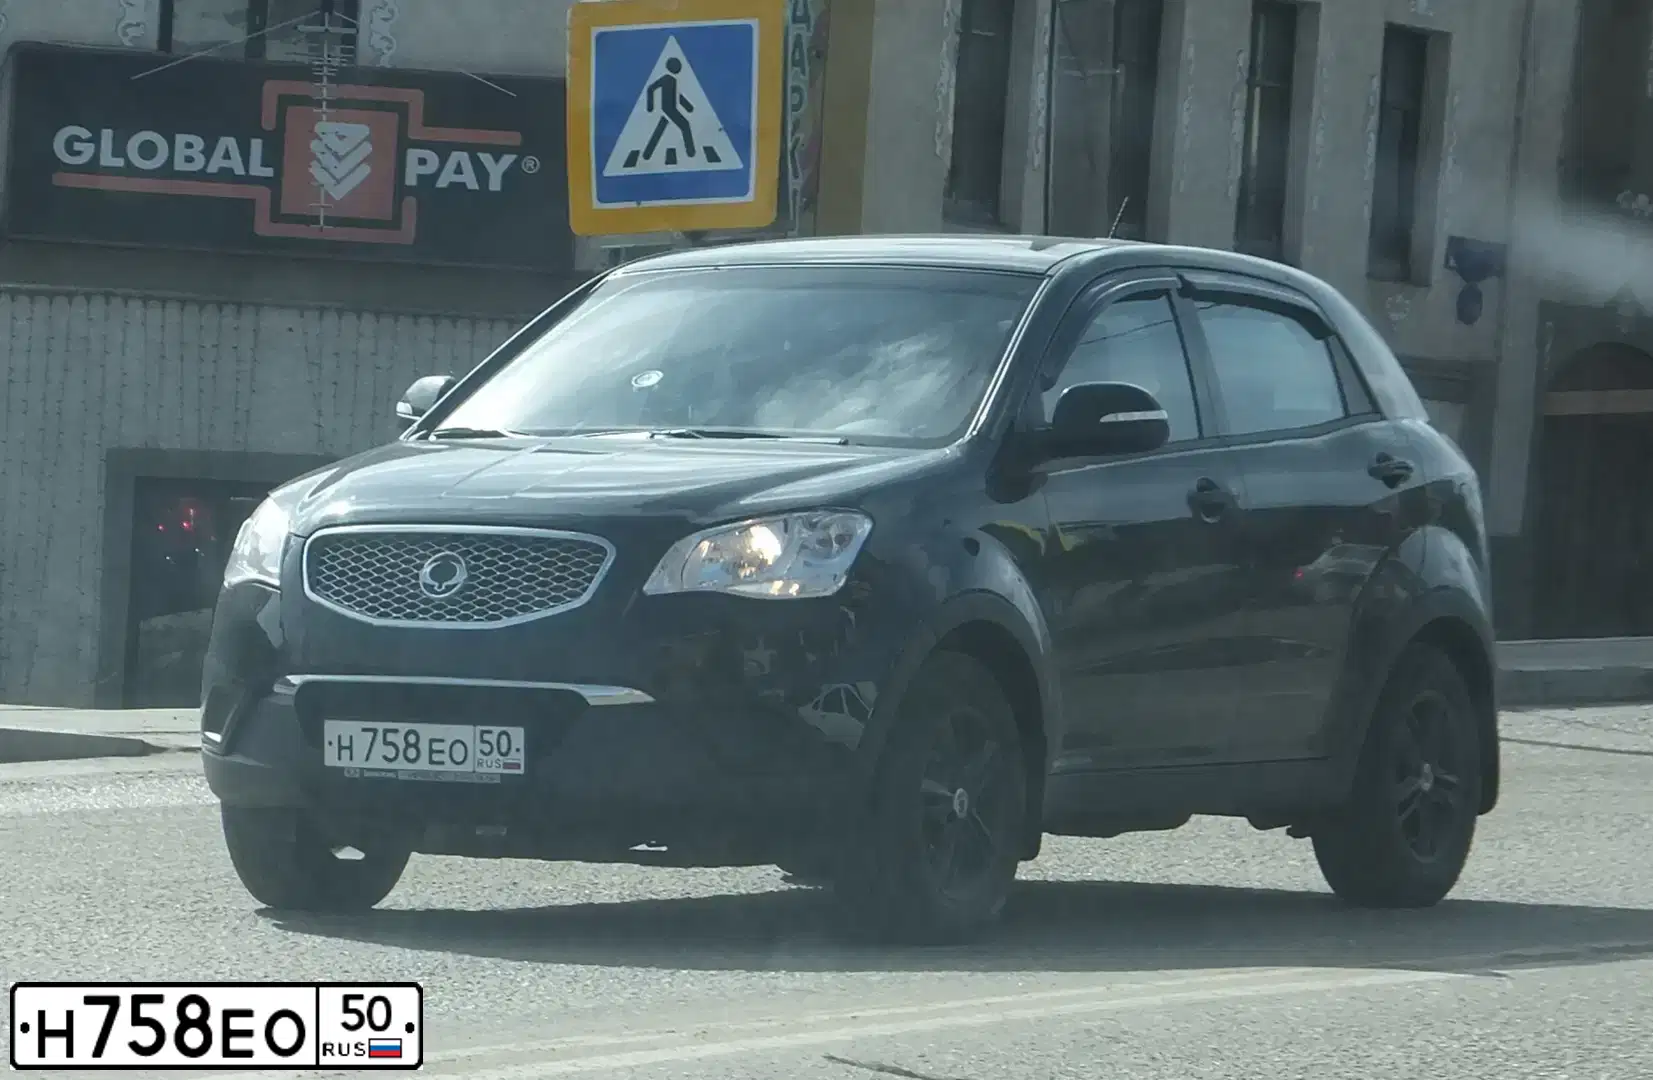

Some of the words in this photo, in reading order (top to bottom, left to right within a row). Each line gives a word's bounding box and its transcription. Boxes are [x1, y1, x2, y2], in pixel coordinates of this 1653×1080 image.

[53, 125, 274, 177] GLOBAL
[479, 729, 511, 757] 50
[477, 759, 501, 769] RUS
